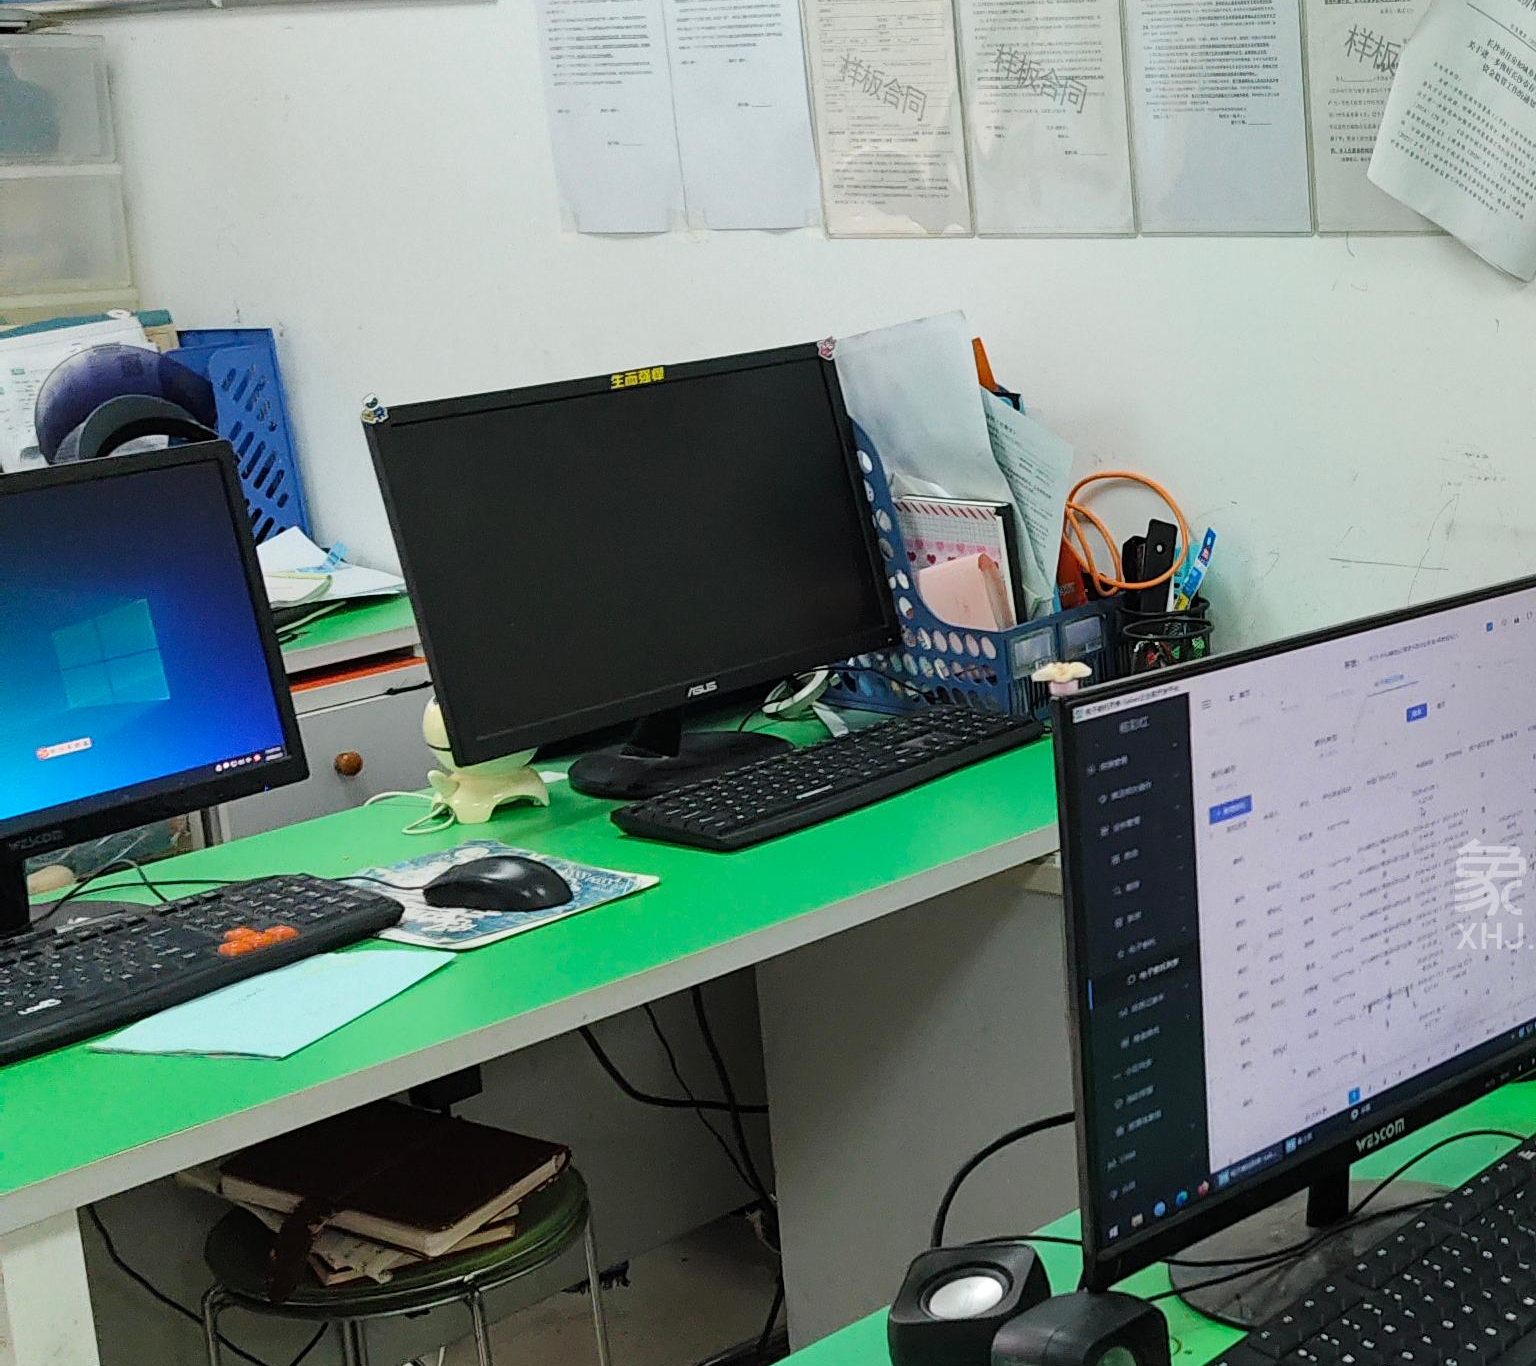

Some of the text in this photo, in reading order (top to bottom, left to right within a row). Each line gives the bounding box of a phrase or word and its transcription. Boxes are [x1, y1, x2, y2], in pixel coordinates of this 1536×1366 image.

[839, 53, 928, 123] 样板合同
[993, 45, 1089, 116] 样板合同
[687, 682, 718, 697] ASUS
